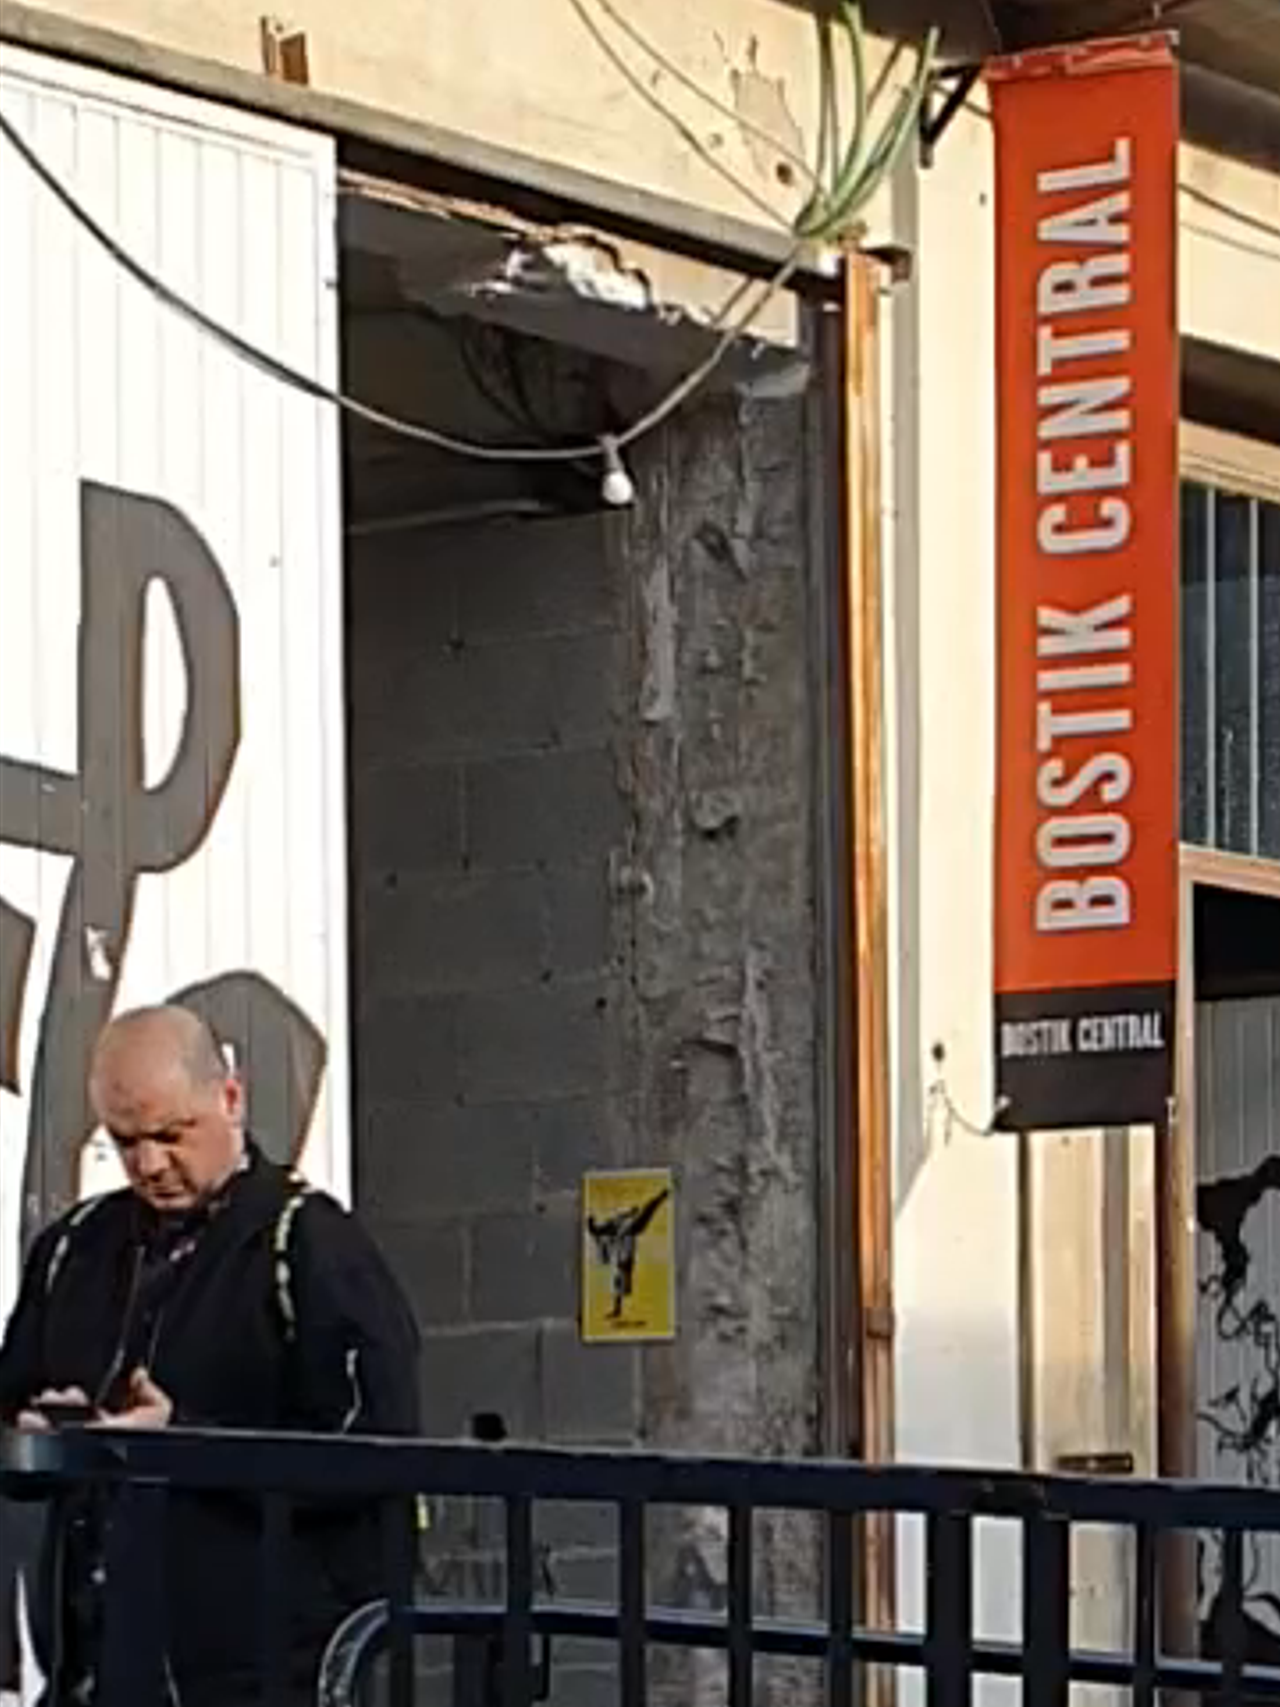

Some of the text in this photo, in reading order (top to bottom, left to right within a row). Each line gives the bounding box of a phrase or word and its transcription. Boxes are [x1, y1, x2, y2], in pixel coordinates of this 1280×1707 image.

[1036, 136, 1132, 932] BOSTIK CENTRAL
[1001, 1010, 1167, 1058] BOSTIK CENTRAL
